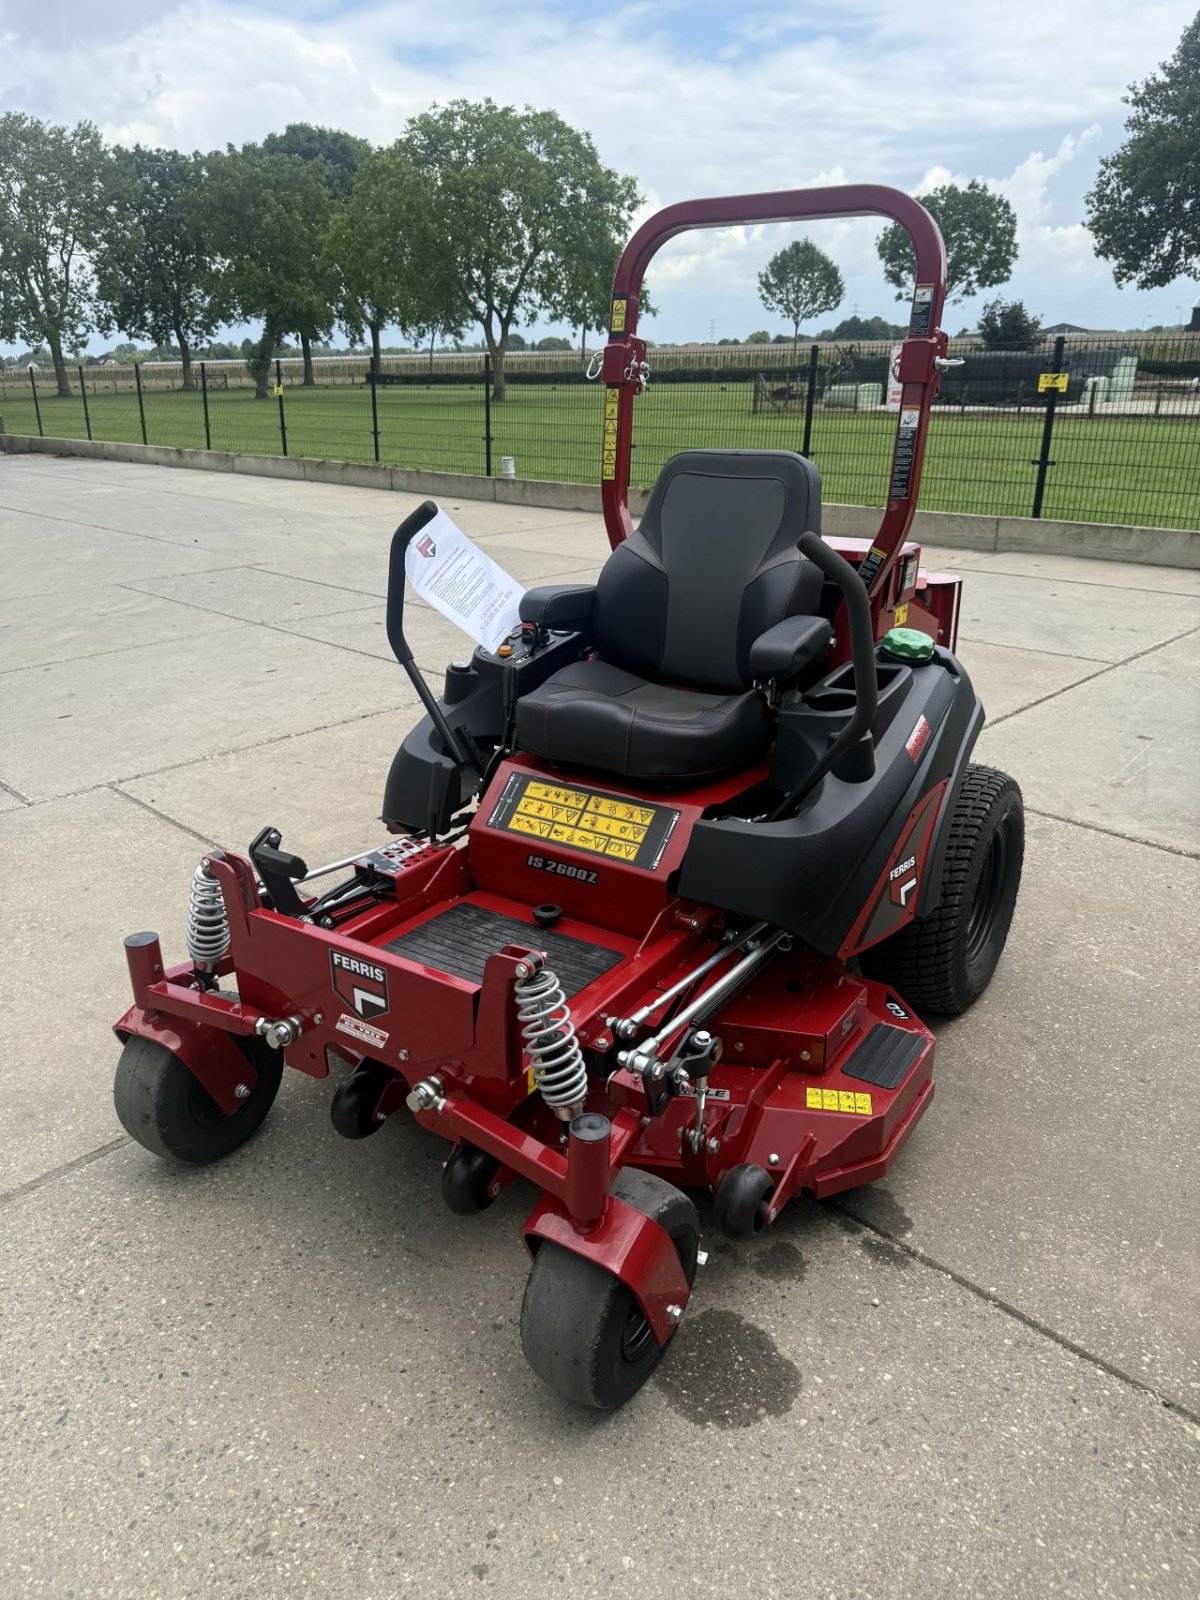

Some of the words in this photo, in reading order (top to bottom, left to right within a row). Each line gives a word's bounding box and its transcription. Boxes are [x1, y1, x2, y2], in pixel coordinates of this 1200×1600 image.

[527, 855, 544, 868] IS
[545, 860, 598, 884] 2600Z
[890, 855, 915, 880] FERRIS
[333, 952, 385, 982] FERRIS
